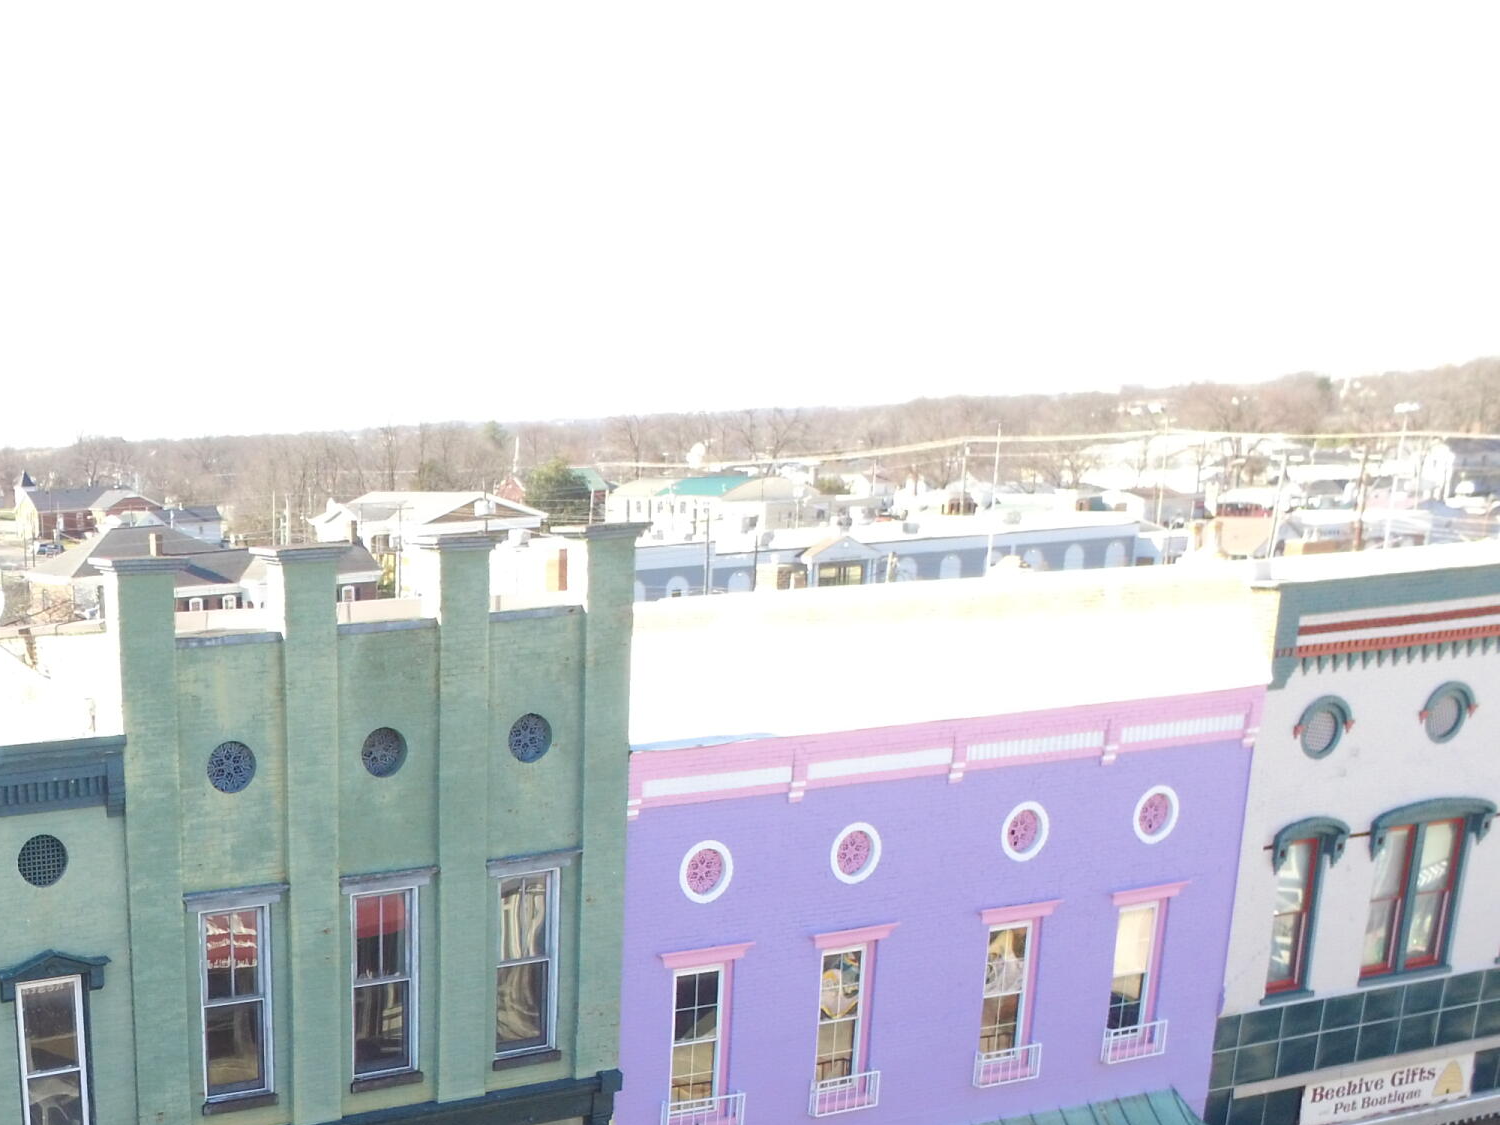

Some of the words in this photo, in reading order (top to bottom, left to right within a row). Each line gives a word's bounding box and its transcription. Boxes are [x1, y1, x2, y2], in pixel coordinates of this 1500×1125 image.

[1310, 1077, 1384, 1103] Beehive
[1390, 1066, 1436, 1087] Gifts
[1333, 1101, 1357, 1115] Pet
[1361, 1088, 1422, 1110] Boutique
